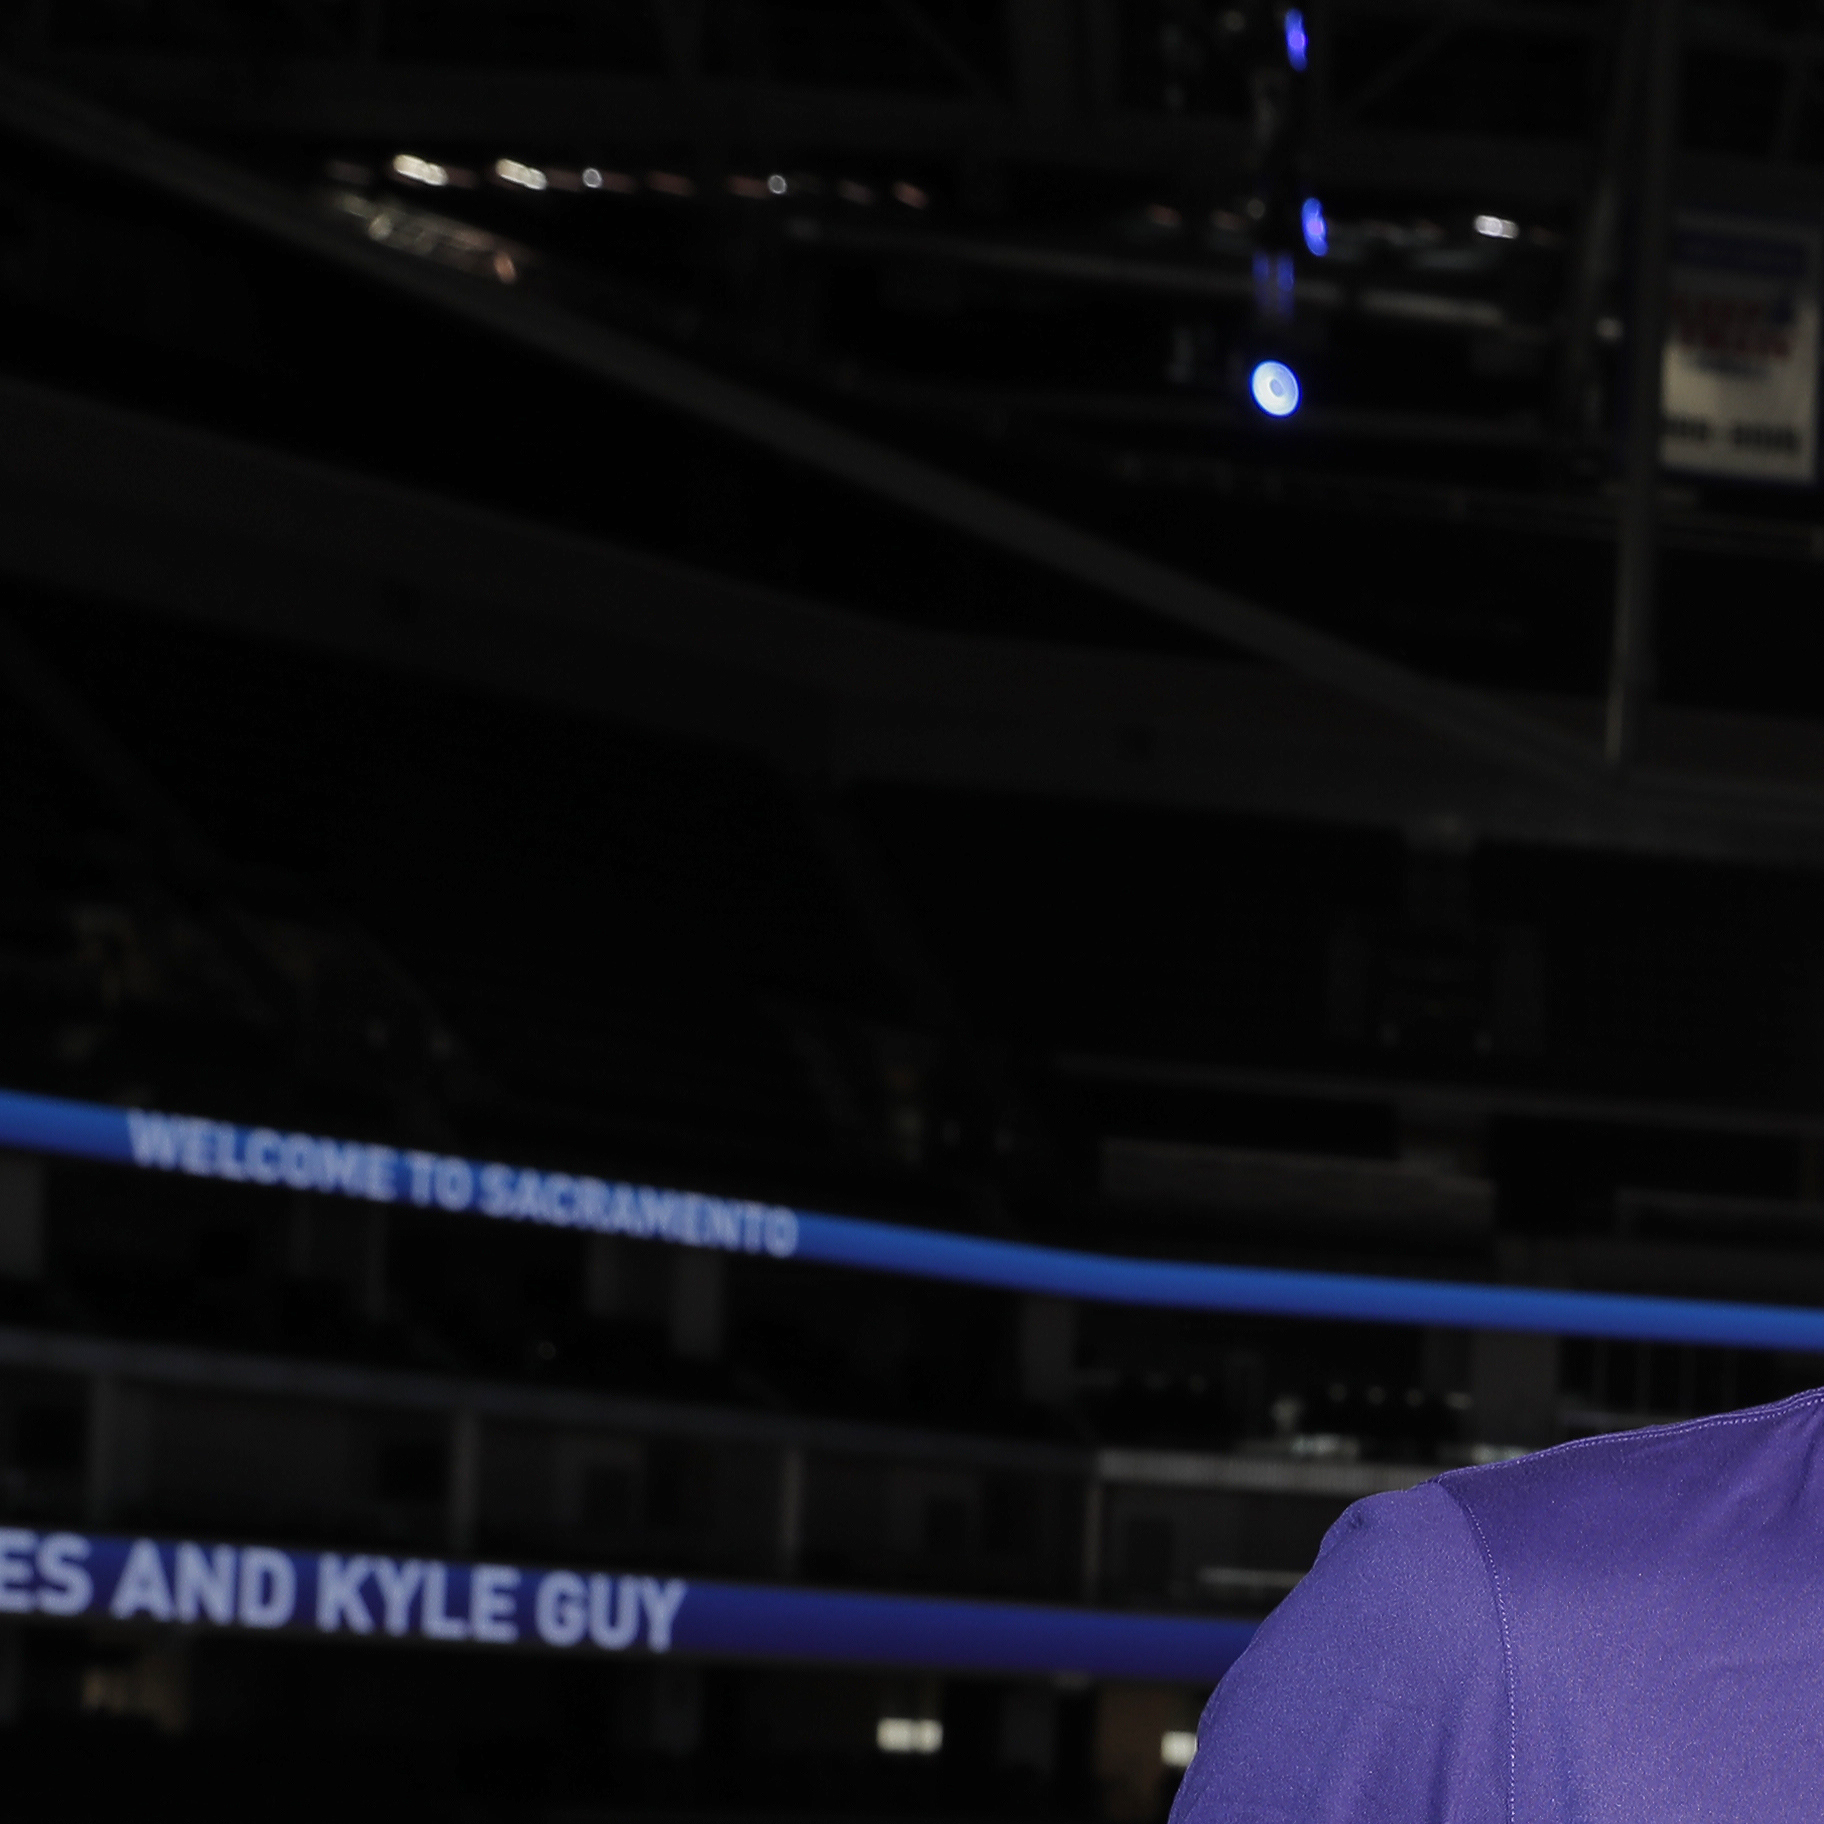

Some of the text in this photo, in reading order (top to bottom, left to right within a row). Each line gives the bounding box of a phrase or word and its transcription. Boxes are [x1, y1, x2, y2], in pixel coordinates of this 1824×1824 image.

[126, 1106, 800, 1259] WELCOME TO SACRAMENTO
[110, 1538, 297, 1631] AND
[314, 1551, 522, 1644] KYLE
[534, 1569, 688, 1654] GUY
